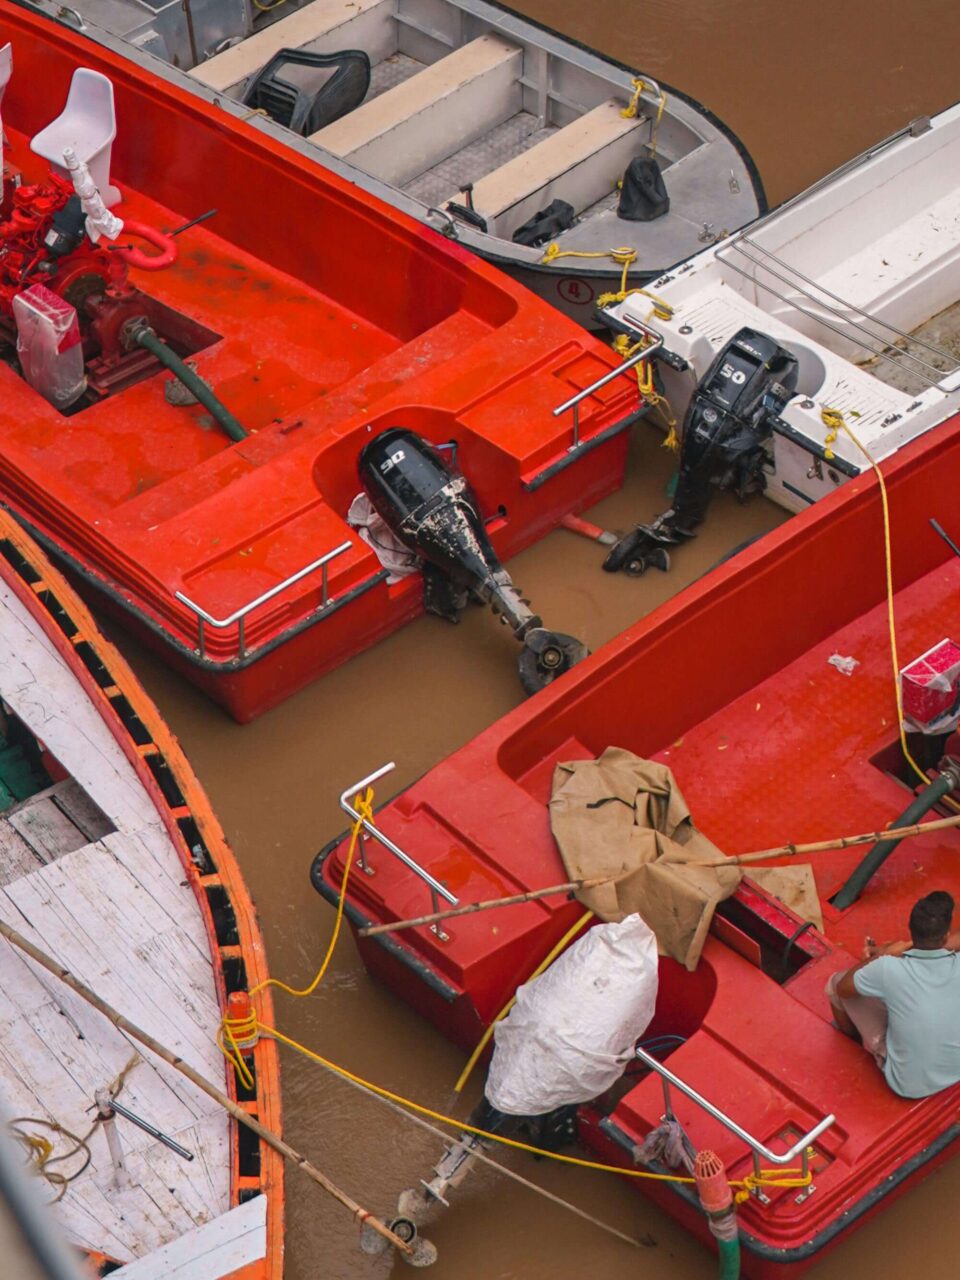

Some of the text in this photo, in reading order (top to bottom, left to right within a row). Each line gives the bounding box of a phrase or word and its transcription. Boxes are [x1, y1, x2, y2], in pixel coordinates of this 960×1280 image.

[568, 282, 580, 297] 4
[719, 363, 746, 385] 50
[380, 450, 406, 475] 90
